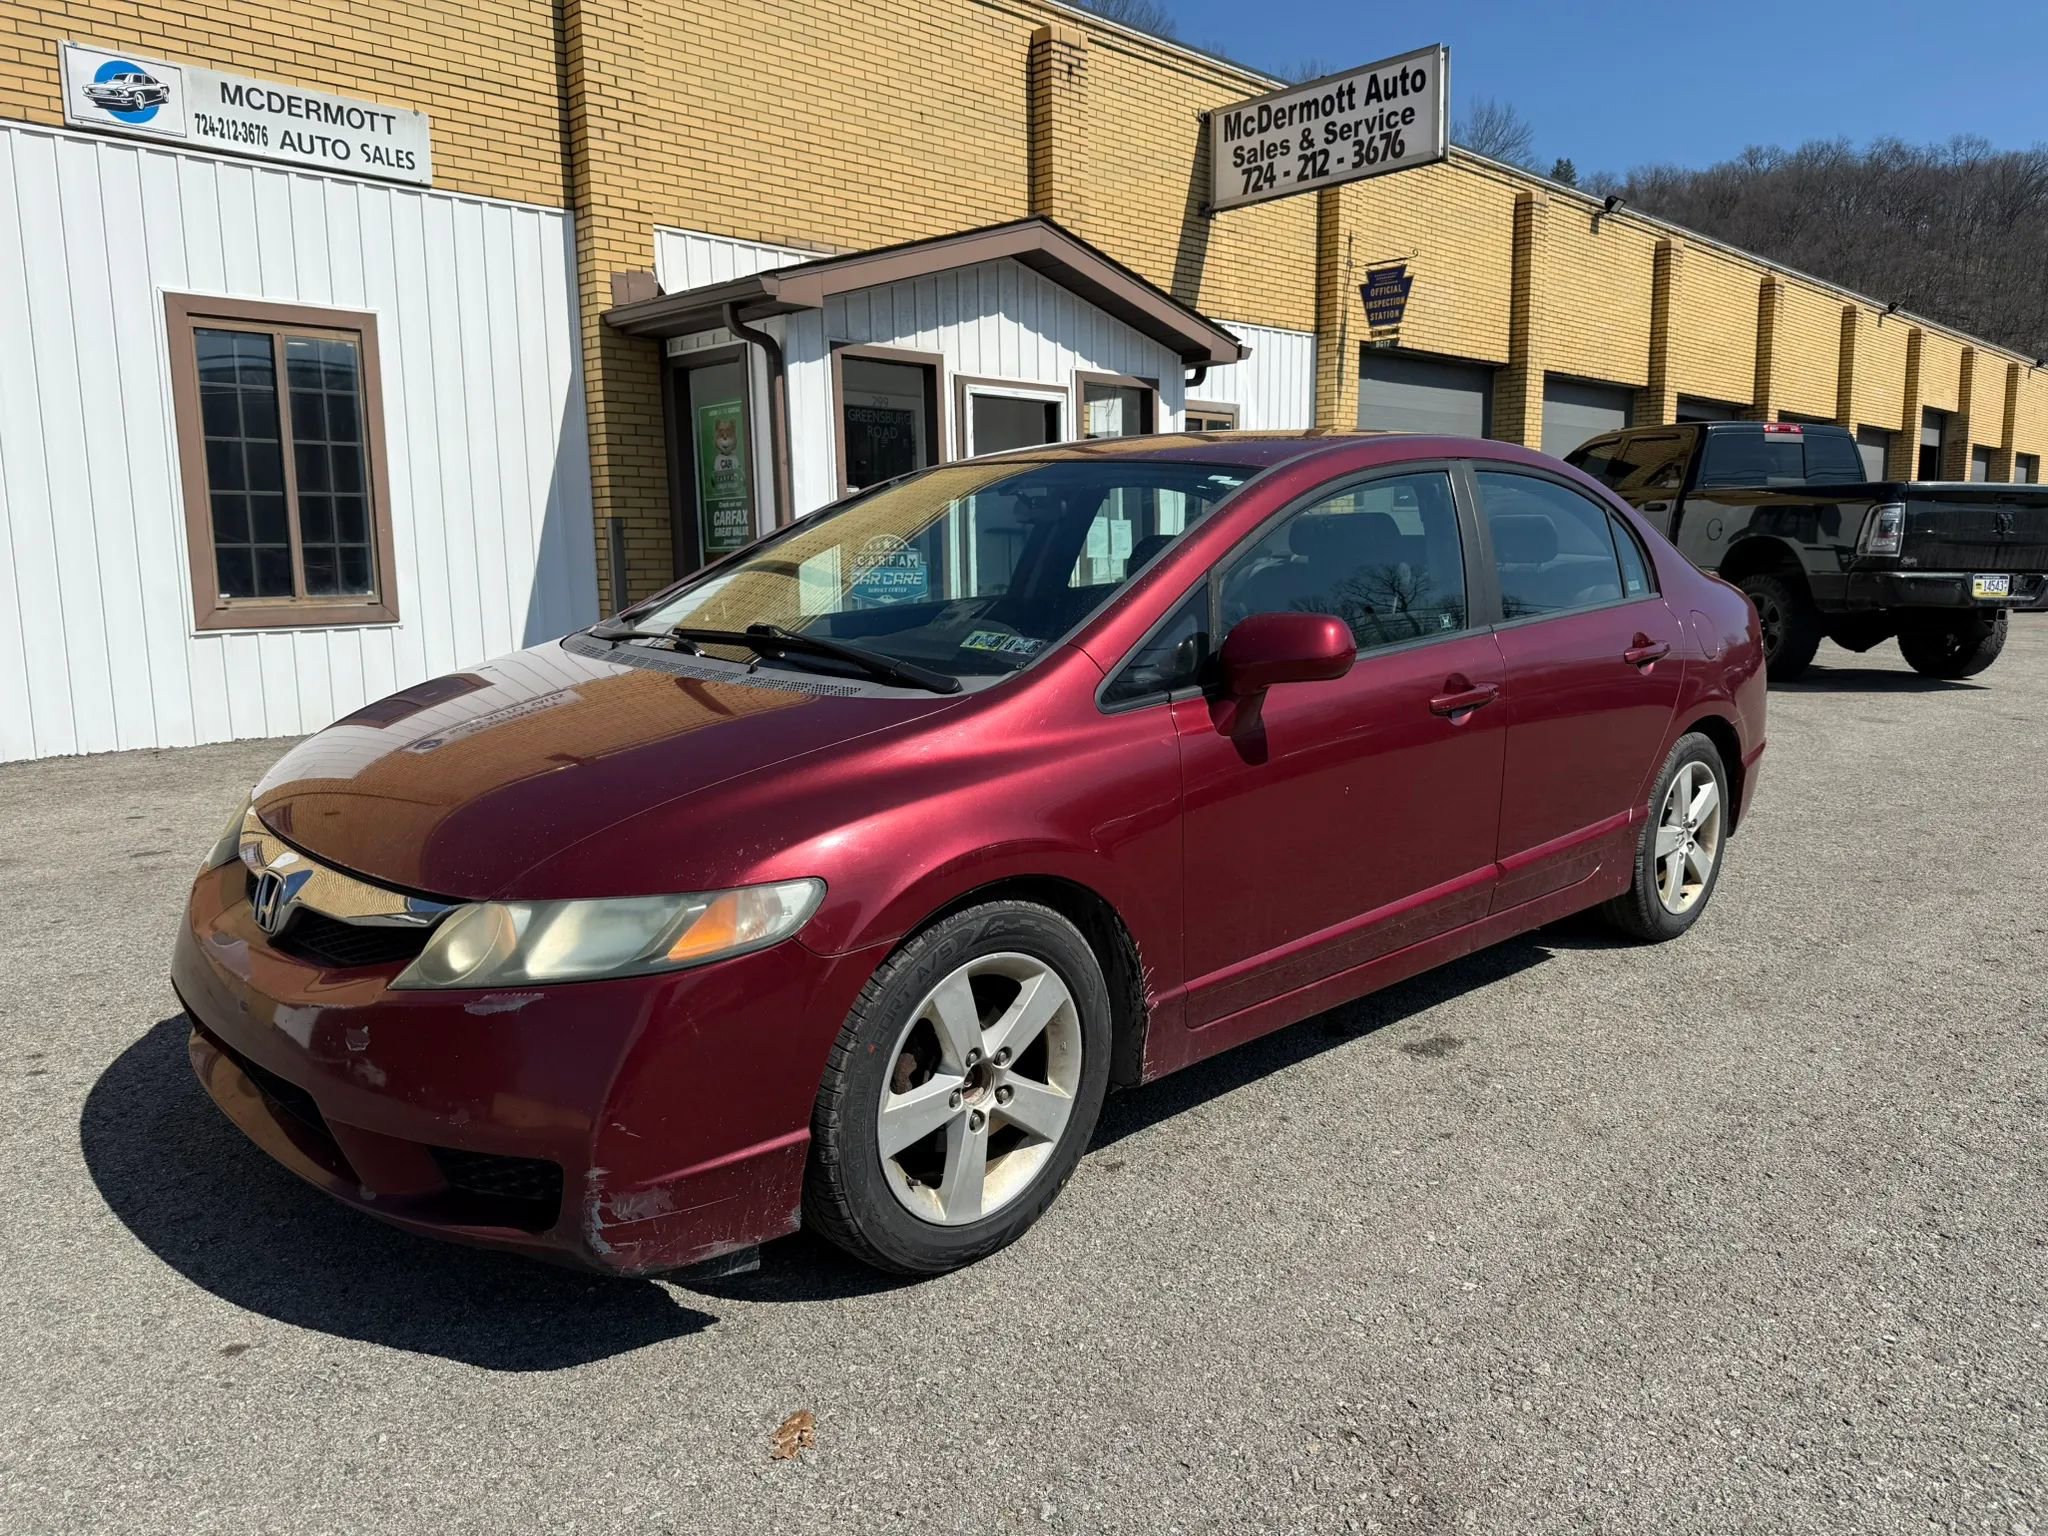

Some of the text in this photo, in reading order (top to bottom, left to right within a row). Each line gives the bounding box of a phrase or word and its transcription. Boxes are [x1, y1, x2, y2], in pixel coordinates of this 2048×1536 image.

[220, 82, 396, 135] MCDERMOTT
[1224, 65, 1426, 143] McDermott Auto
[194, 113, 268, 147] 724-212-3676
[1232, 106, 1416, 168] Sales & Service
[279, 130, 415, 171] AUTO SALES
[1370, 284, 1402, 297] OFFICIAL
[1365, 295, 1406, 309] INSPECTION
[1370, 310, 1400, 321] STATION
[867, 425, 898, 439] ROAD
[713, 509, 748, 526] CARFAX
[856, 554, 916, 568] CARFAX
[883, 572, 923, 585] CARE
